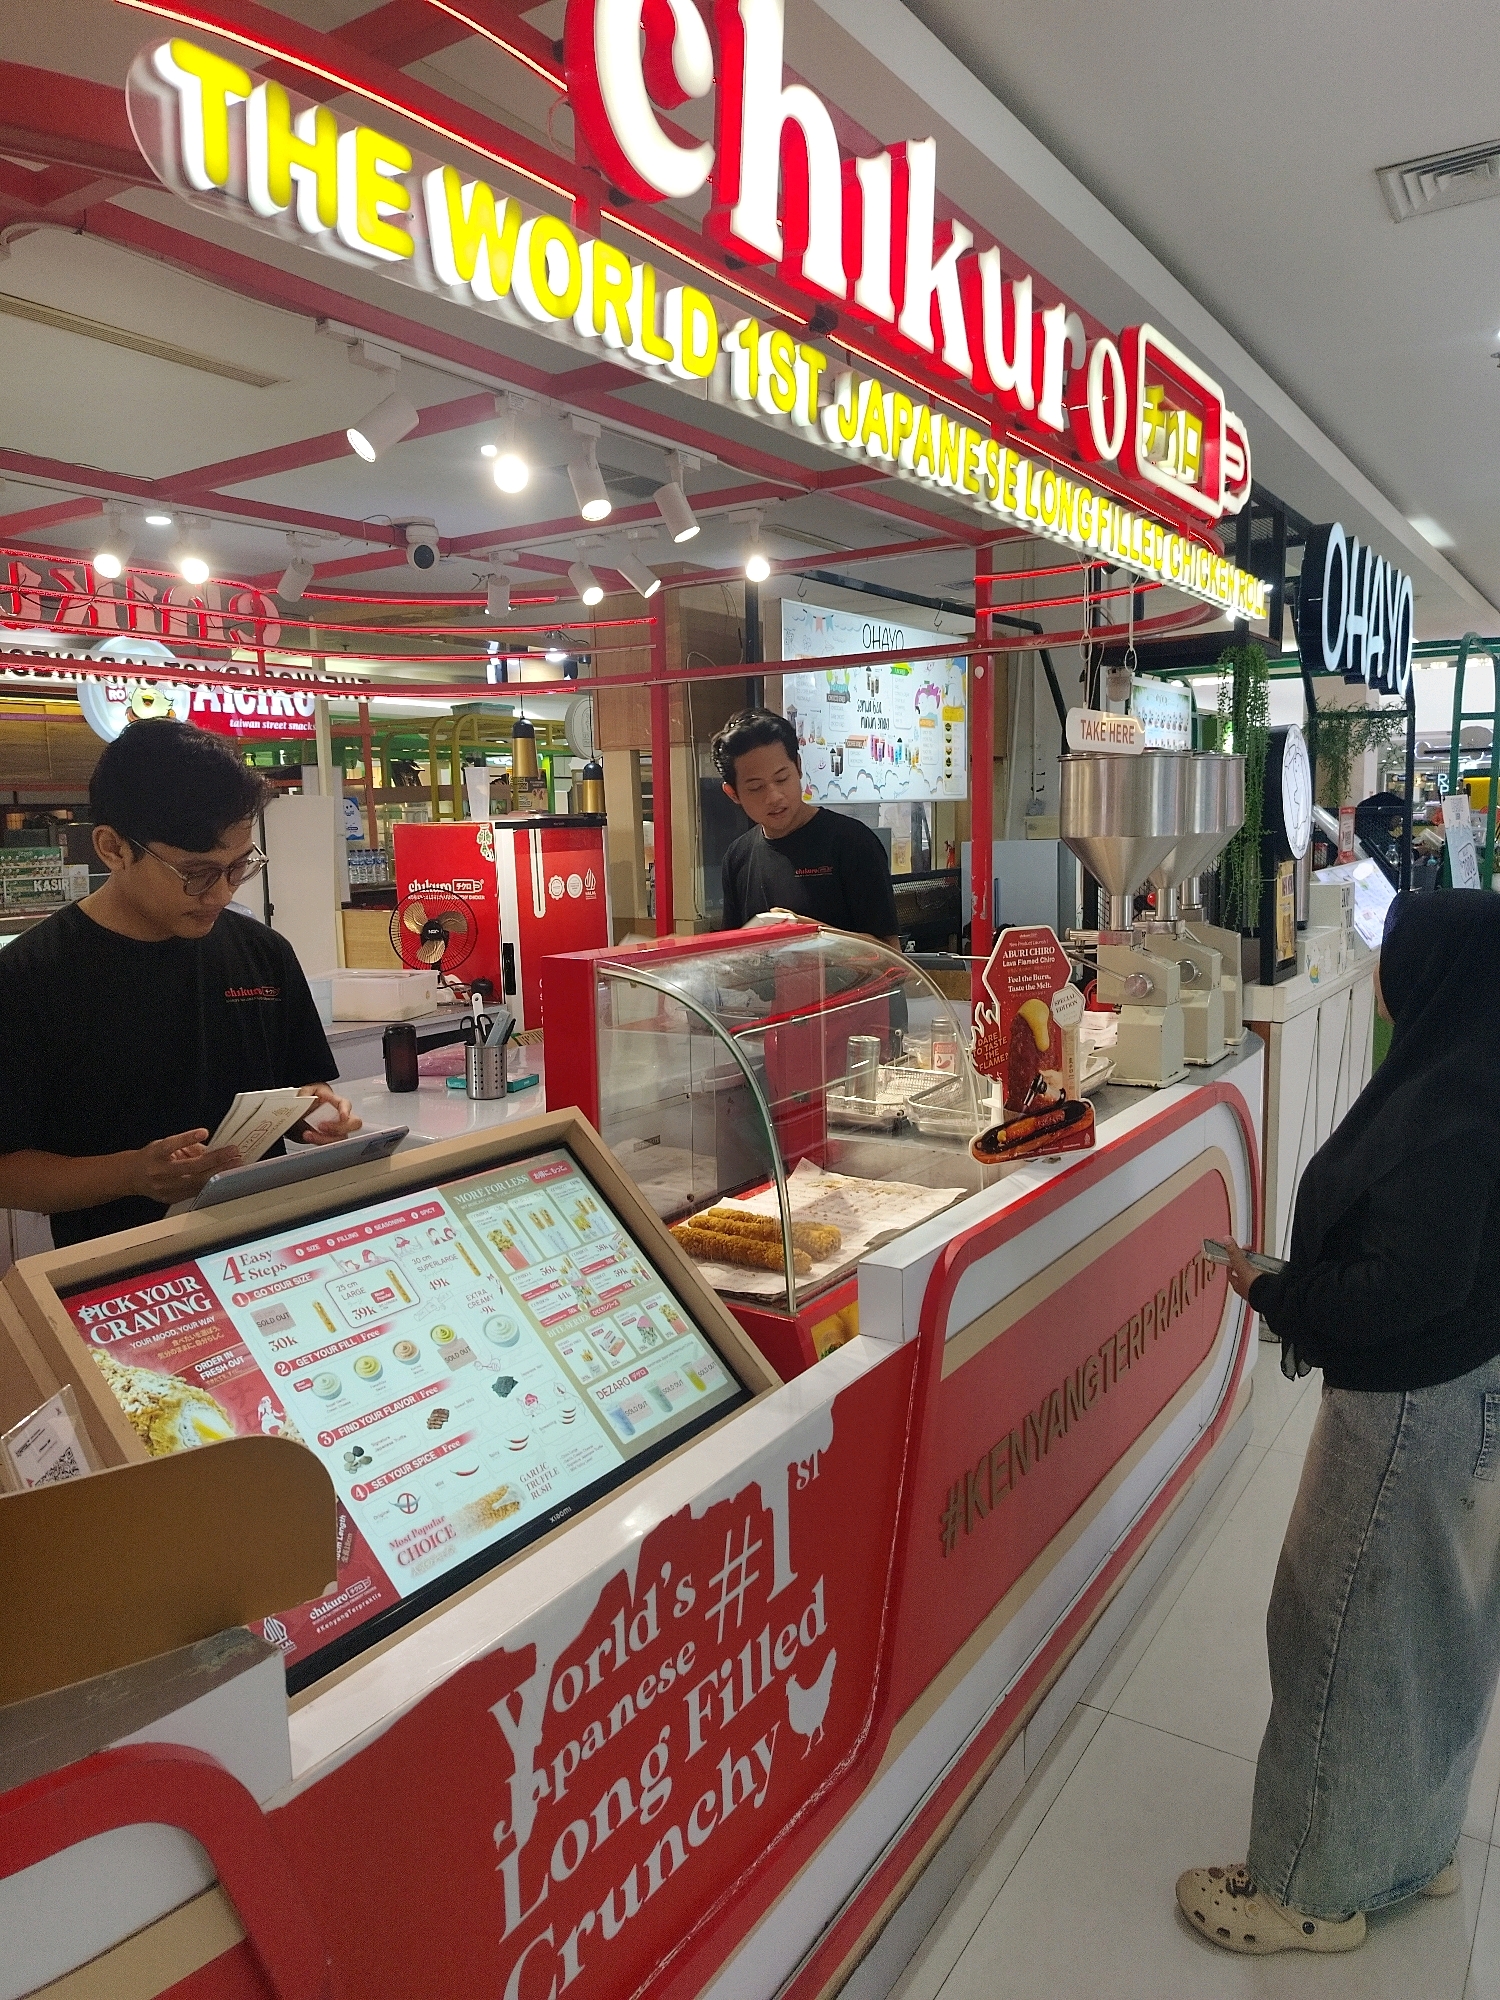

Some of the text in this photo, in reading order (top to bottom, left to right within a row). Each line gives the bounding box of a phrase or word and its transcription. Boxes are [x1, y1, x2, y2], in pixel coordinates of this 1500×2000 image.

[154, 38, 1268, 619] THE WORLD 1ST JAPANESE LONG FILLED CHICKEN ROLL
[1321, 521, 1414, 697] OHAYO
[230, 719, 260, 729] taiwan
[262, 720, 287, 730] street
[1080, 719, 1135, 745] TAKE HERE
[33, 878, 70, 893] KASIR
[1002, 946, 1056, 959] ABURI CHIRO
[1017, 957, 1039, 966] Flamed
[1008, 976, 1022, 984] Feel
[1008, 985, 1025, 993] Taste
[1025, 983, 1036, 991] the
[1054, 993, 1076, 1006] SPECIAL
[1055, 1000, 1078, 1013] EDITION
[973, 1036, 1008, 1058] TO TASTE
[977, 1032, 998, 1047] DARE
[979, 1052, 1009, 1072] FLAME?
[984, 1048, 1000, 1060] THE
[453, 1188, 485, 1202] MORE
[484, 1181, 506, 1194] FOR
[504, 1175, 529, 1187] LESS
[419, 1207, 435, 1215] SPICY
[373, 1216, 406, 1230] SEASONING
[336, 1231, 359, 1242] FILLING
[222, 1251, 271, 1284] 4 Easy
[416, 1253, 458, 1272] SUPERLARGE
[248, 1263, 287, 1280] Steps
[252, 1288, 268, 1298] GO
[267, 1280, 293, 1293] YOUR
[292, 1273, 312, 1284] SIZE
[335, 1284, 346, 1292] 25
[429, 1277, 450, 1290] 49k
[78, 1276, 202, 1324] PICK YOUR
[341, 1287, 365, 1300] LARGE
[465, 1288, 487, 1301] EXTRA
[467, 1294, 493, 1309] CREAMY
[91, 1293, 211, 1343] CRAVING
[256, 1312, 289, 1328] SOLD OUT
[351, 1305, 377, 1319] 39k
[129, 1337, 152, 1349] YOUR
[177, 1321, 199, 1332] YOUR
[197, 1315, 216, 1325] WAY
[268, 1336, 297, 1351] 30k
[193, 1350, 234, 1372] ORDER IN
[276, 1330, 379, 1375] 2 GET YOUR FILL Free
[444, 1345, 471, 1362] SOLD OUT
[198, 1363, 228, 1380] FRESH
[227, 1355, 244, 1367] OUT
[697, 1361, 716, 1377] SOLD OUT
[595, 1376, 630, 1399] DEZARO
[662, 1379, 683, 1394] SOLD OUT
[320, 1386, 438, 1444] 3 FIND YOUR FLAVOR Free
[624, 1400, 647, 1416] SOLD OUT
[355, 1440, 460, 1498] 4 SET YOUR SPICE Free
[519, 1462, 546, 1482] GARLIC
[526, 1467, 557, 1491] TRUFFLE
[530, 1482, 552, 1500] RUSH
[389, 1515, 444, 1548] Most Popular
[397, 1524, 456, 1566] CHOICE
[309, 1592, 348, 1620] chikuro
[495, 1573, 829, 1944] Long Filled
[503, 1722, 782, 2000] Crunchy
